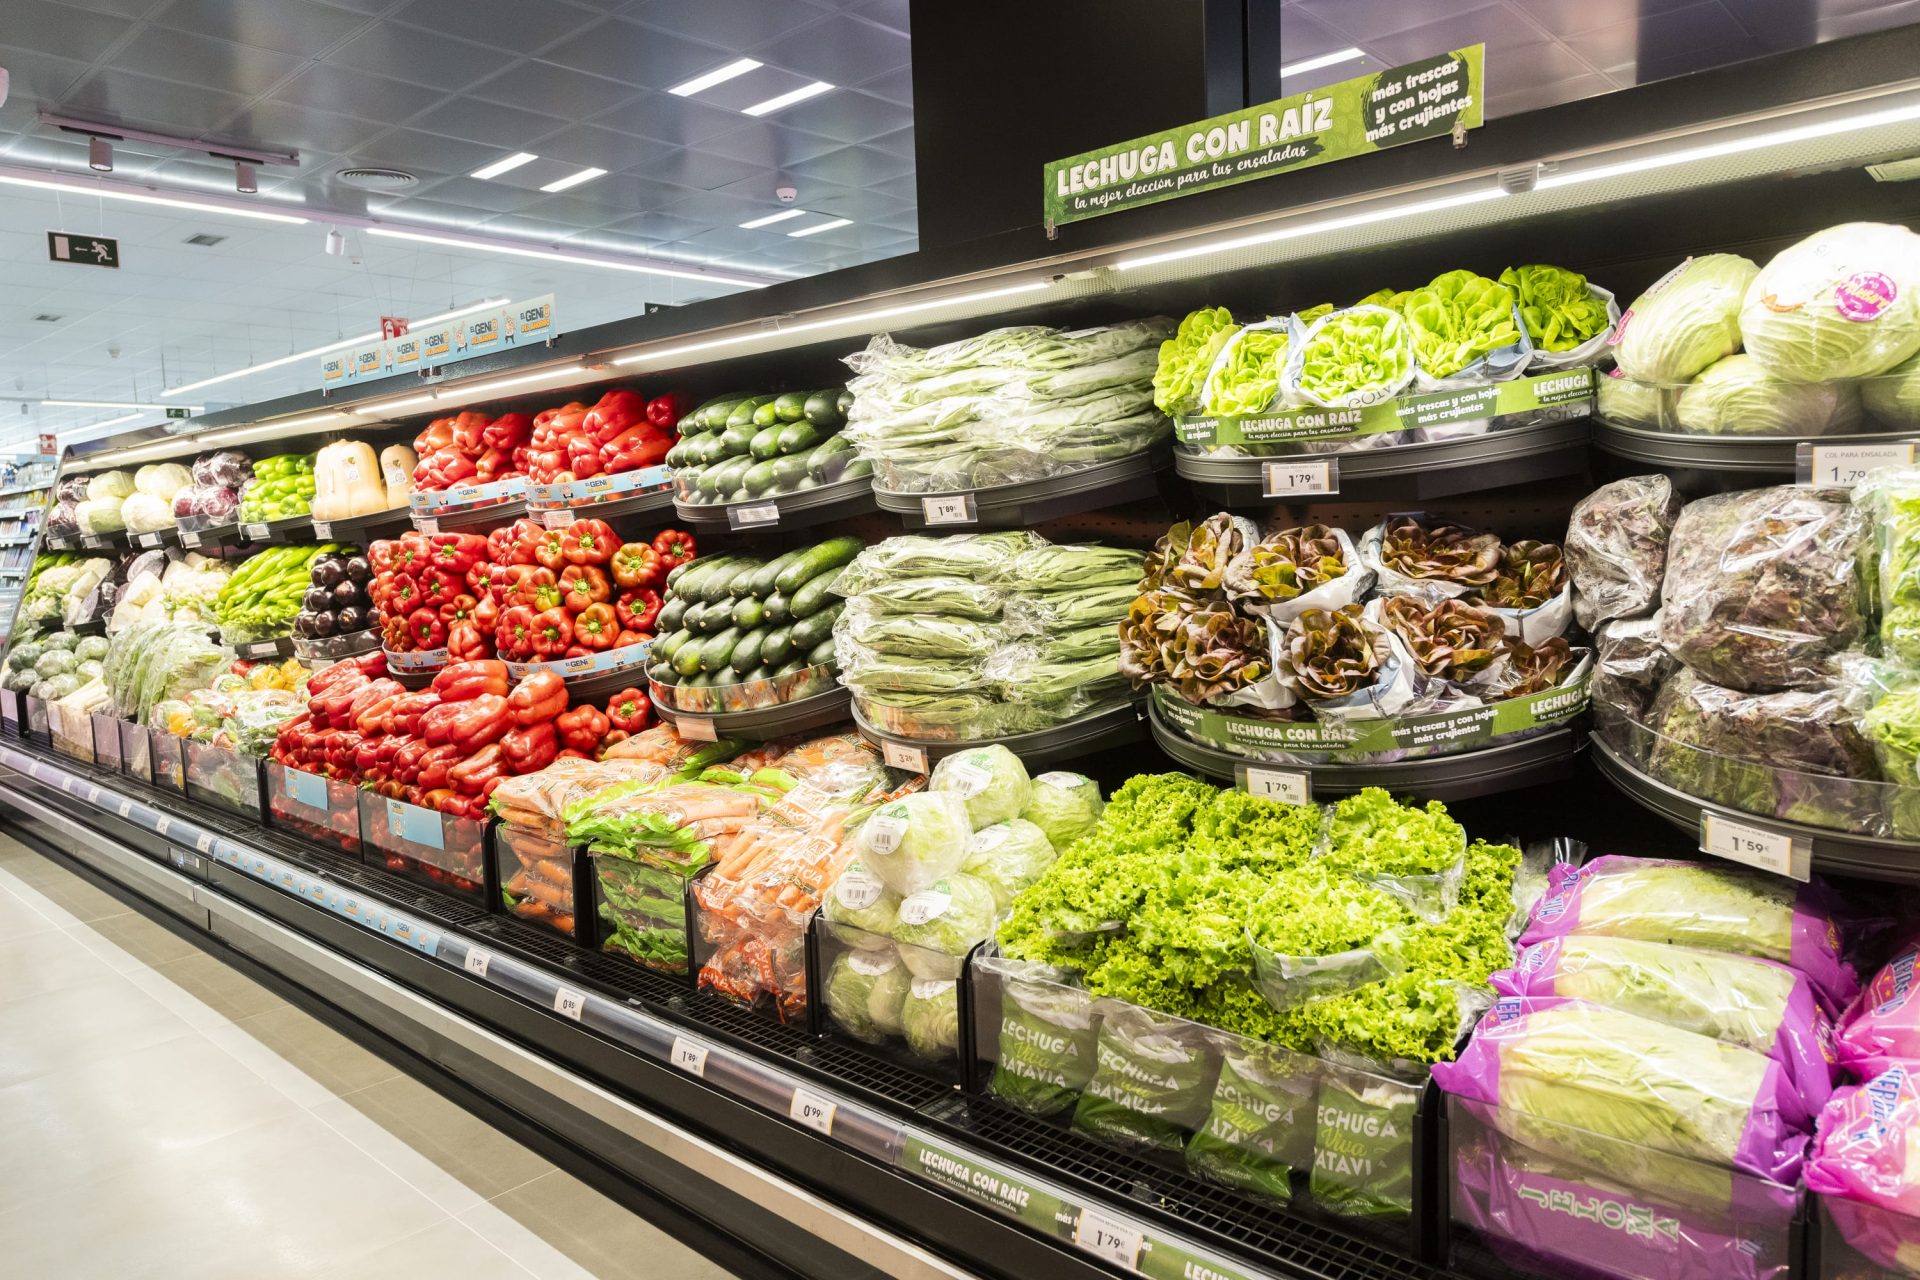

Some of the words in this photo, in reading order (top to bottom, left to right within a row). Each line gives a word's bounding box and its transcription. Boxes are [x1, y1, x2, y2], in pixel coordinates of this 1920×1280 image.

[1372, 81, 1402, 102] más
[1405, 60, 1459, 89] frescas
[1375, 106, 1386, 124] y
[1389, 96, 1415, 115] con
[1418, 80, 1459, 104] hojas
[1365, 122, 1396, 143] más
[1398, 95, 1473, 127] crujientes
[1057, 140, 1178, 198] LECHUGA
[1186, 119, 1250, 163] CON
[1258, 92, 1334, 147] RAÍZ
[1074, 197, 1088, 209] la
[1090, 192, 1123, 207] mejor
[1126, 179, 1175, 198] elección
[1177, 170, 1209, 190] para
[1212, 162, 1233, 176] tus
[1237, 145, 1310, 171] ensaladas
[1533, 374, 1589, 395] LECHUGA
[1396, 404, 1416, 416] más
[1417, 398, 1450, 412] frescas
[1452, 398, 1459, 407] y
[1460, 392, 1477, 403] con
[1478, 387, 1502, 401] hojas
[1417, 412, 1437, 423] más
[1439, 402, 1484, 418] crujientes
[1239, 417, 1293, 433] LECHUGA
[1295, 413, 1326, 428] CON
[1320, 425, 1352, 435] ensaladas
[1860, 450, 1898, 458] ENSALADA
[1530, 690, 1583, 715] LECHUGA
[1226, 721, 1283, 740] LECHUGA
[1286, 728, 1317, 741] CON
[1391, 727, 1411, 737] más
[1412, 720, 1447, 733] frescas
[1448, 718, 1455, 729] y
[1457, 714, 1474, 725] con
[1474, 708, 1499, 723] hojas
[1414, 735, 1434, 744] más
[1435, 724, 1480, 740] crujientes
[1001, 1017, 1079, 1057] LECHUGA
[1215, 1078, 1294, 1125] ECHUGA
[1317, 1105, 1398, 1138] ECHUGA
[1314, 1146, 1388, 1176] ATAVIA
[920, 1148, 970, 1182] LECHUGA
[972, 1171, 999, 1194] CON
[1000, 1182, 1030, 1208] RAÍZ
[1055, 1211, 1072, 1225] más
